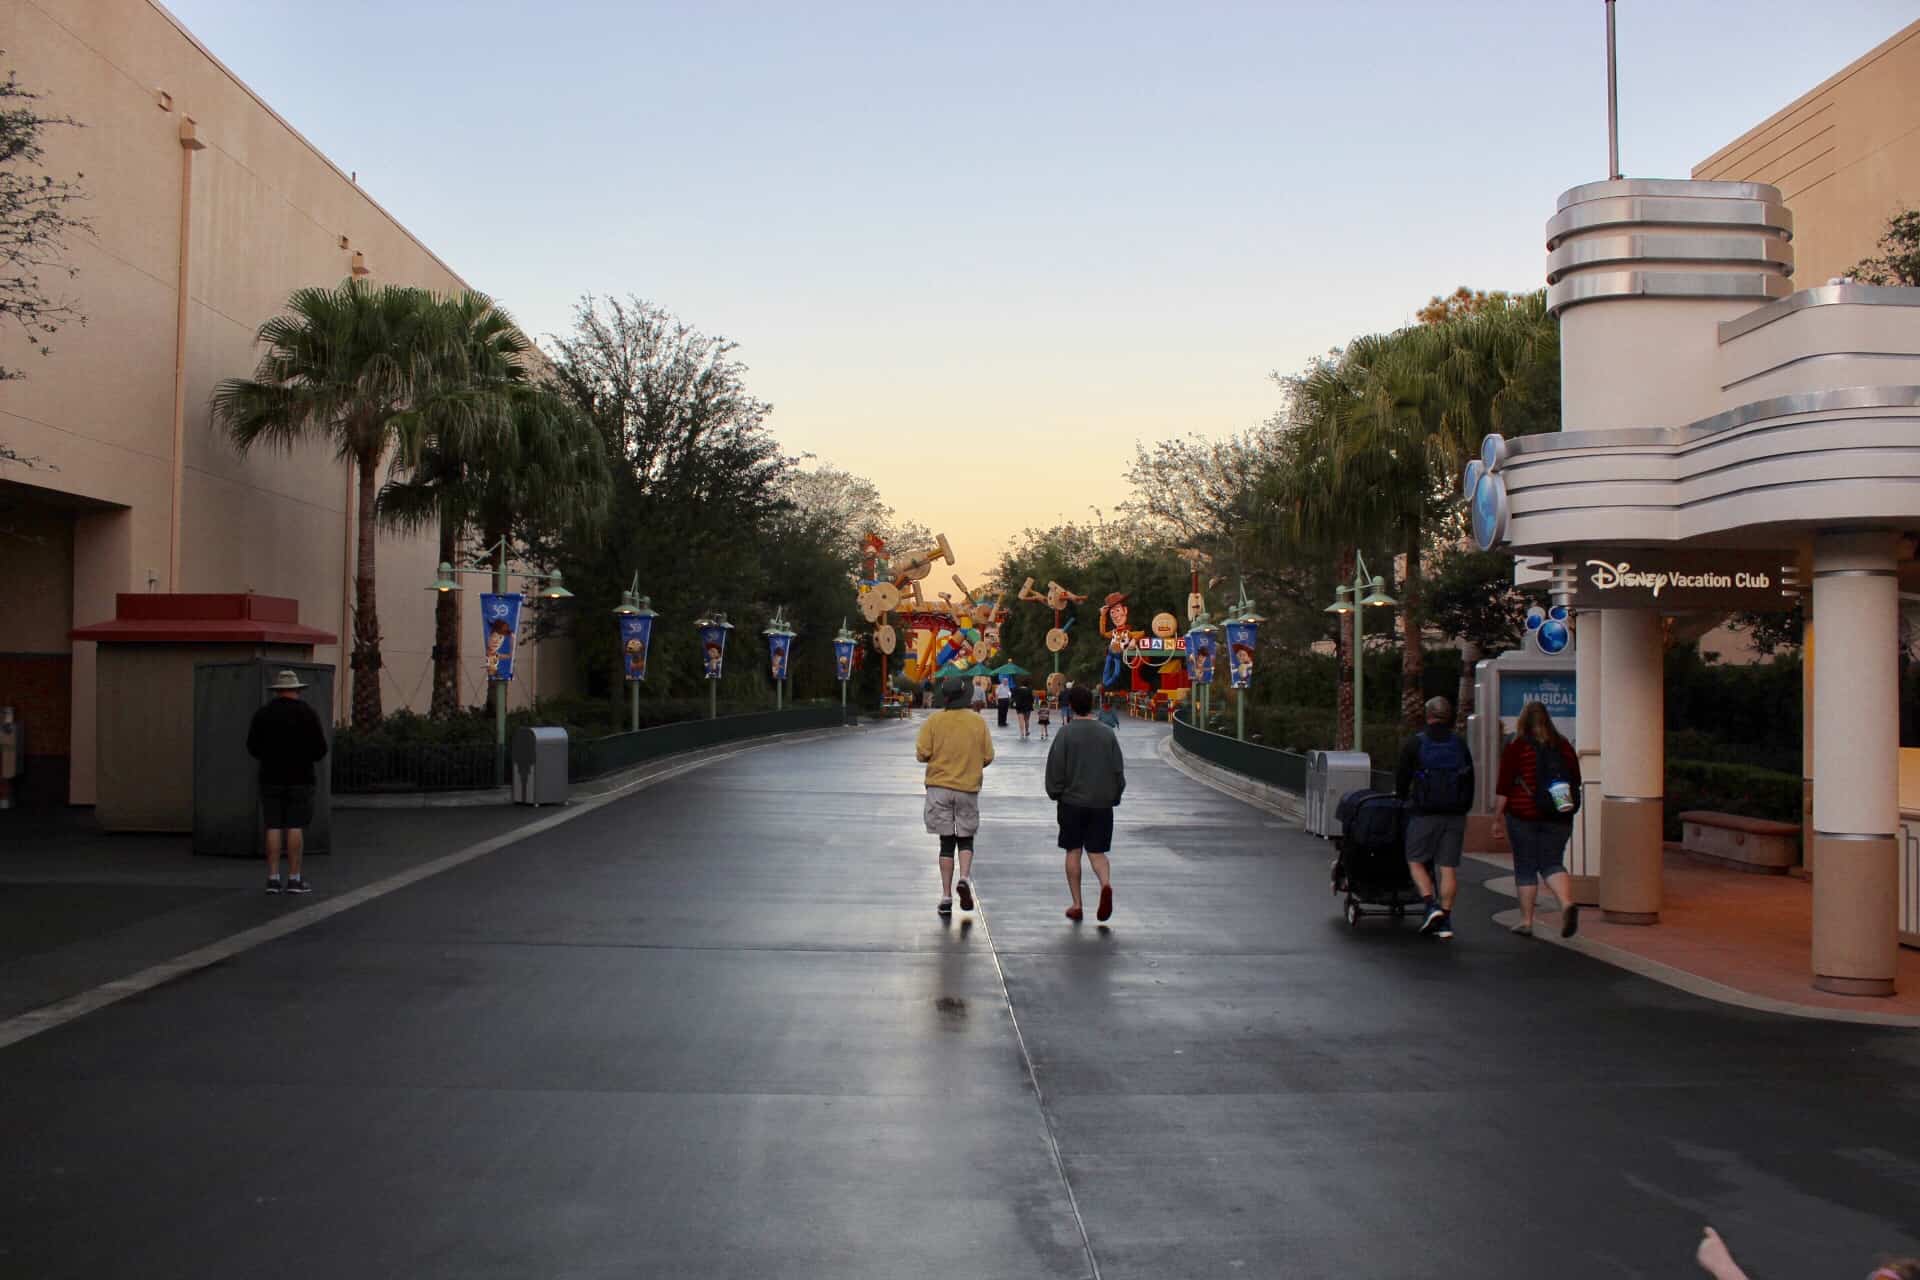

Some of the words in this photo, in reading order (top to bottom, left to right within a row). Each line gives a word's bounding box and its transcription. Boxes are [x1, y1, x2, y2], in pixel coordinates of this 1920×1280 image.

[1585, 559, 1668, 597] Disney
[1668, 570, 1732, 588] Vacation
[1735, 572, 1770, 588] Club
